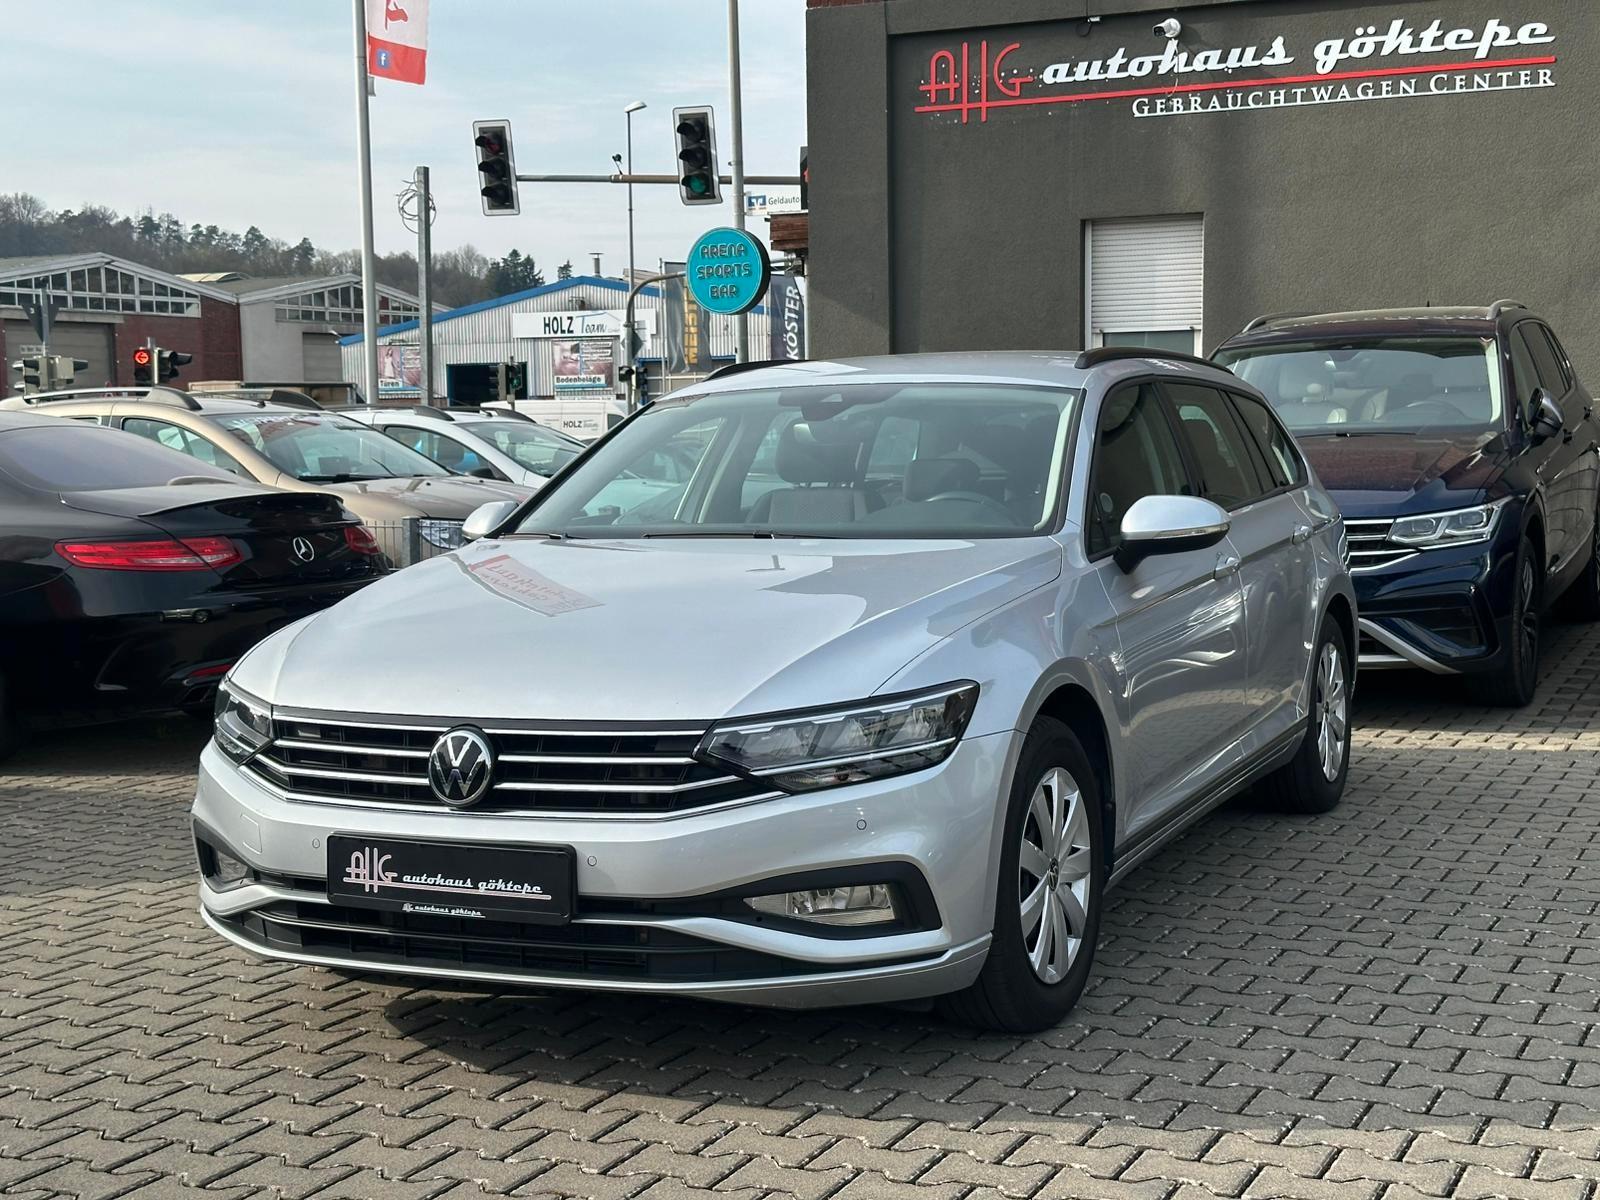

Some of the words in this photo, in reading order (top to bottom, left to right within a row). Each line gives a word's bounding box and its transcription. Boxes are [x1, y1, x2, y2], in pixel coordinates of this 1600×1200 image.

[919, 40, 1034, 123] AHG
[1043, 36, 1295, 84] autohaus
[1314, 18, 1556, 75] göktepe
[1132, 78, 1417, 117] GEBRAUCHTWAGEN
[1429, 68, 1556, 95] CENTER
[700, 243, 746, 259] ARENA
[696, 262, 751, 280] SPORTS
[709, 284, 738, 299] BAR
[543, 316, 574, 335] HOLZ
[783, 285, 801, 360] KÖSTER
[563, 420, 583, 429] HOLZ
[345, 846, 399, 894] AHG
[402, 872, 474, 889] autohaus
[478, 877, 544, 895] göktepe
[414, 904, 450, 914] autohaus
